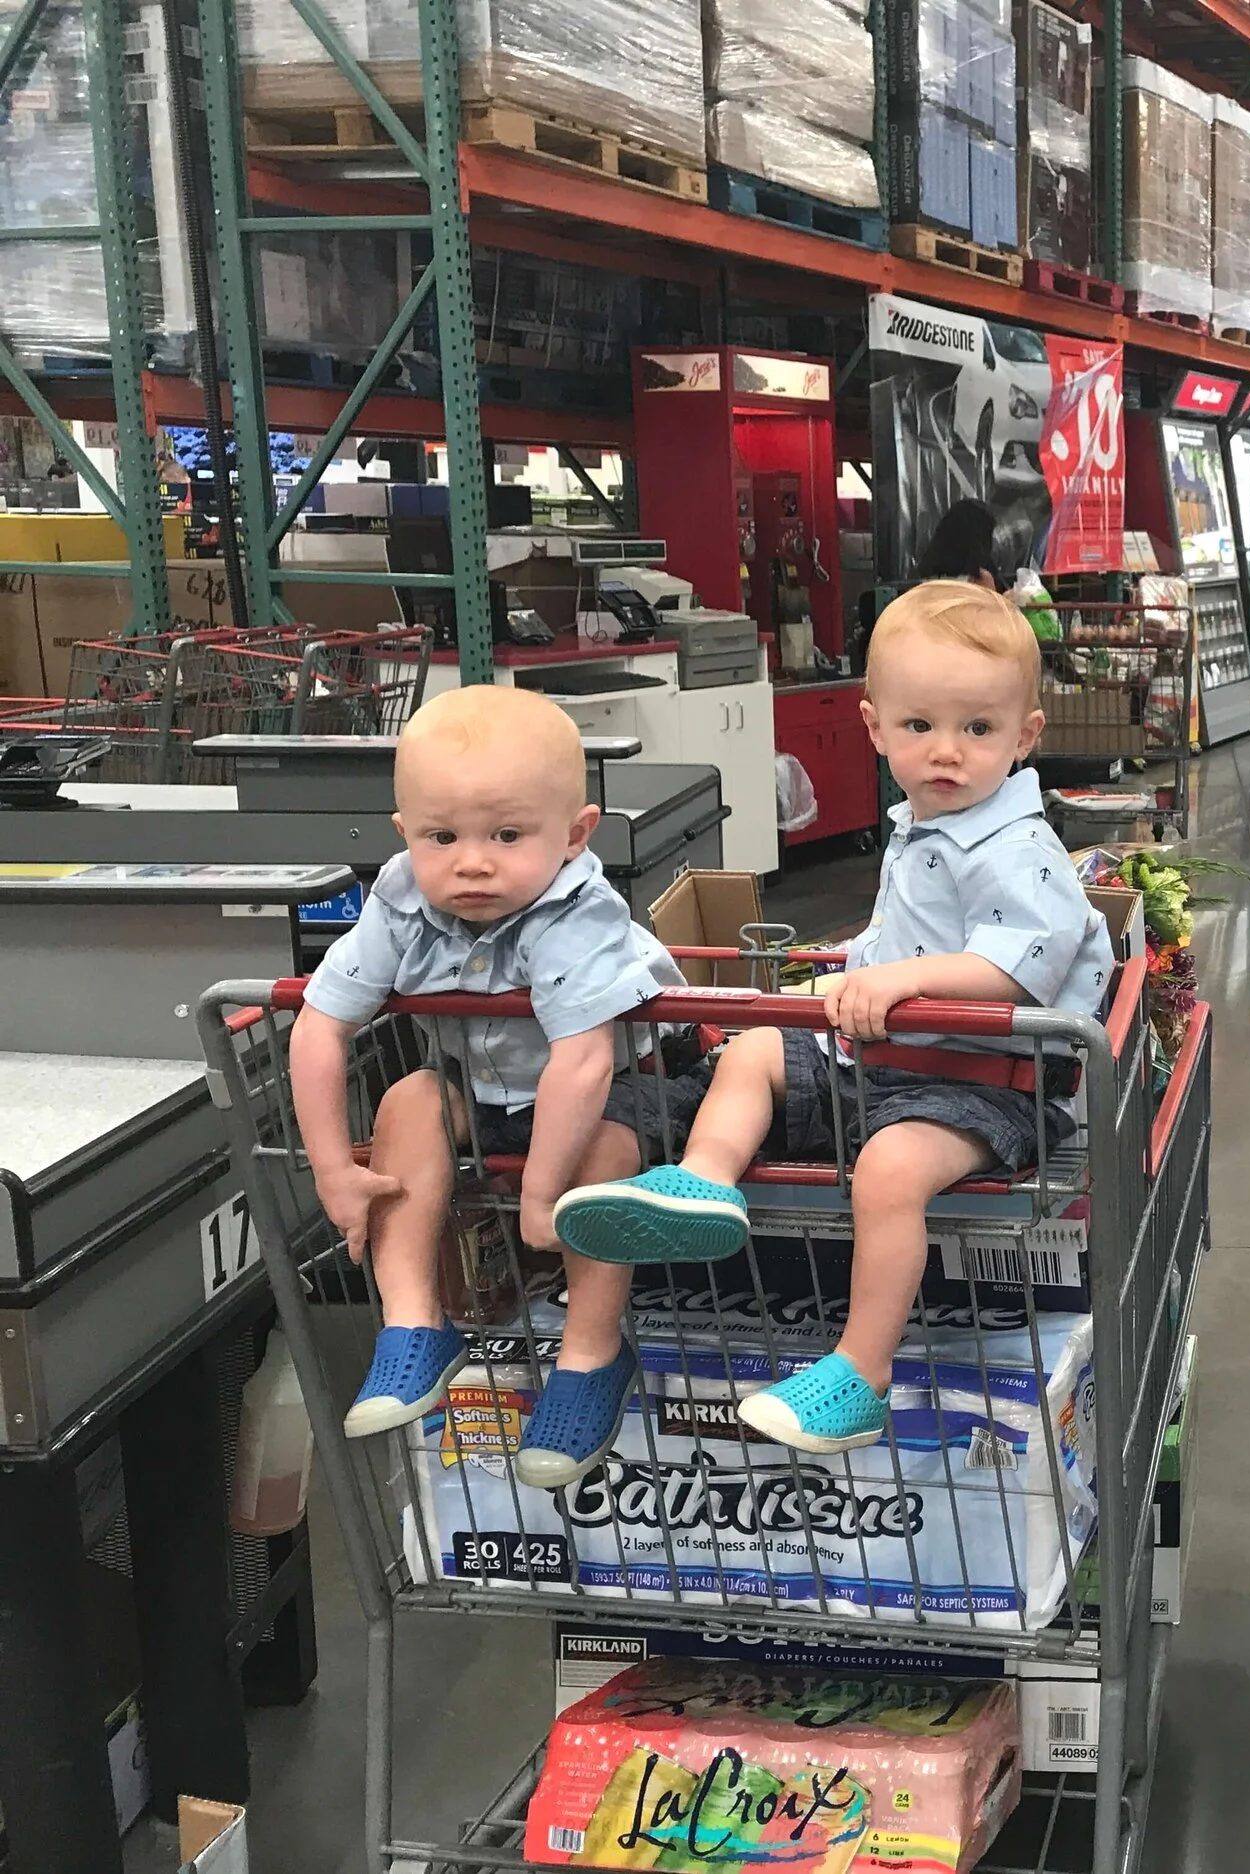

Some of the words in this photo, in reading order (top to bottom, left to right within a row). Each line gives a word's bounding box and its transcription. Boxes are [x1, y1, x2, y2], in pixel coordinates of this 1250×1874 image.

[903, 134, 912, 204] ORGANIZER
[887, 309, 976, 352] BRIDGESTONE
[209, 1193, 249, 1291] 17
[692, 1321, 711, 1335] of
[782, 1327, 813, 1343] and
[454, 1409, 511, 1424] Softnes
[563, 1455, 730, 1530] Bath
[732, 1470, 922, 1536] Tissue
[624, 1538, 631, 1550] 2
[677, 1537, 690, 1549] of
[693, 1539, 746, 1553] sofness
[464, 1541, 499, 1560] 30
[513, 1542, 562, 1567] 425
[534, 1566, 545, 1574] PER
[546, 1566, 562, 1575] ROLL
[695, 1578, 700, 1588] x
[702, 1575, 713, 1589] 4.0
[939, 1599, 968, 1609] SEPTIC
[970, 1598, 1009, 1609] SYSTEMS
[1153, 1602, 1166, 1613] 02
[567, 1639, 642, 1655] KIRKLAND
[568, 1770, 598, 1779] WATER
[896, 1793, 909, 1803] 24
[873, 1833, 880, 1842] 6
[870, 1846, 880, 1855] 12
